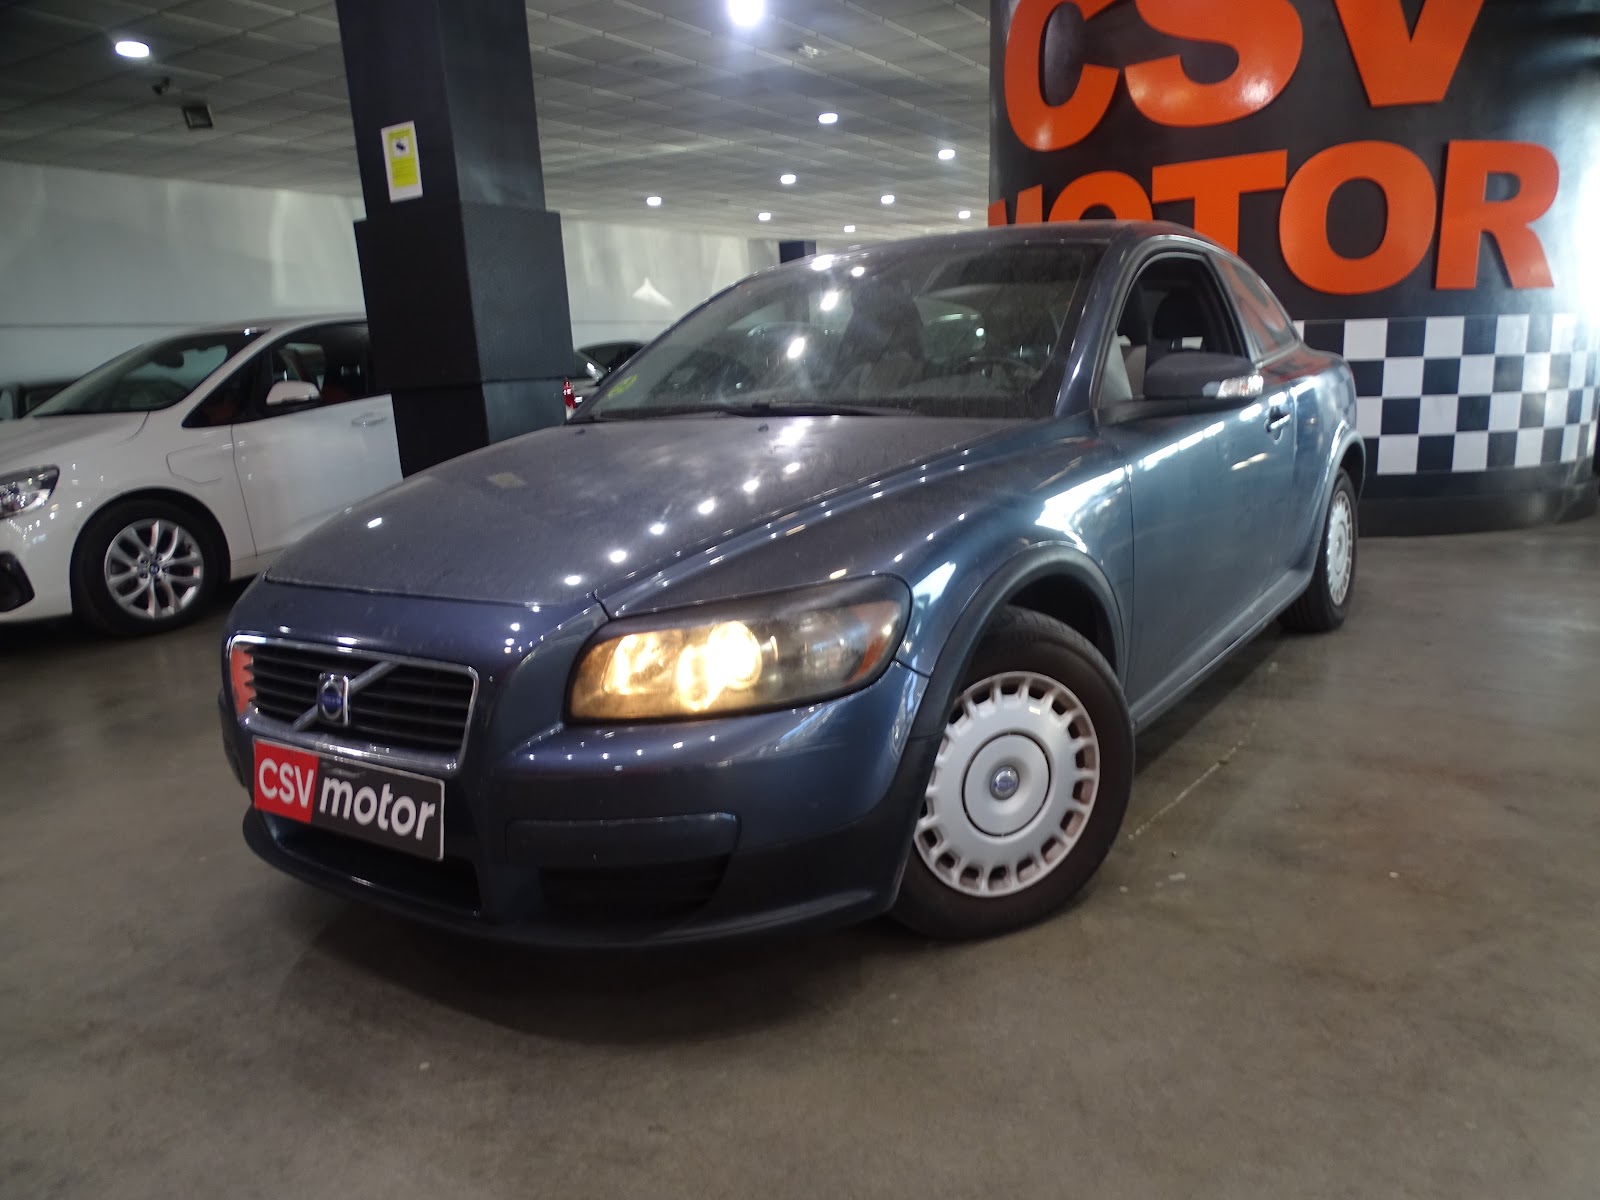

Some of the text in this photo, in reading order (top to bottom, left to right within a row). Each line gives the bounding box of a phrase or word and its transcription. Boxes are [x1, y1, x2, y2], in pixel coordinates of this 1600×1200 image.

[1004, 0, 1484, 151] CSV
[988, 140, 1559, 294] TOR
[259, 758, 436, 840] CSV motor
